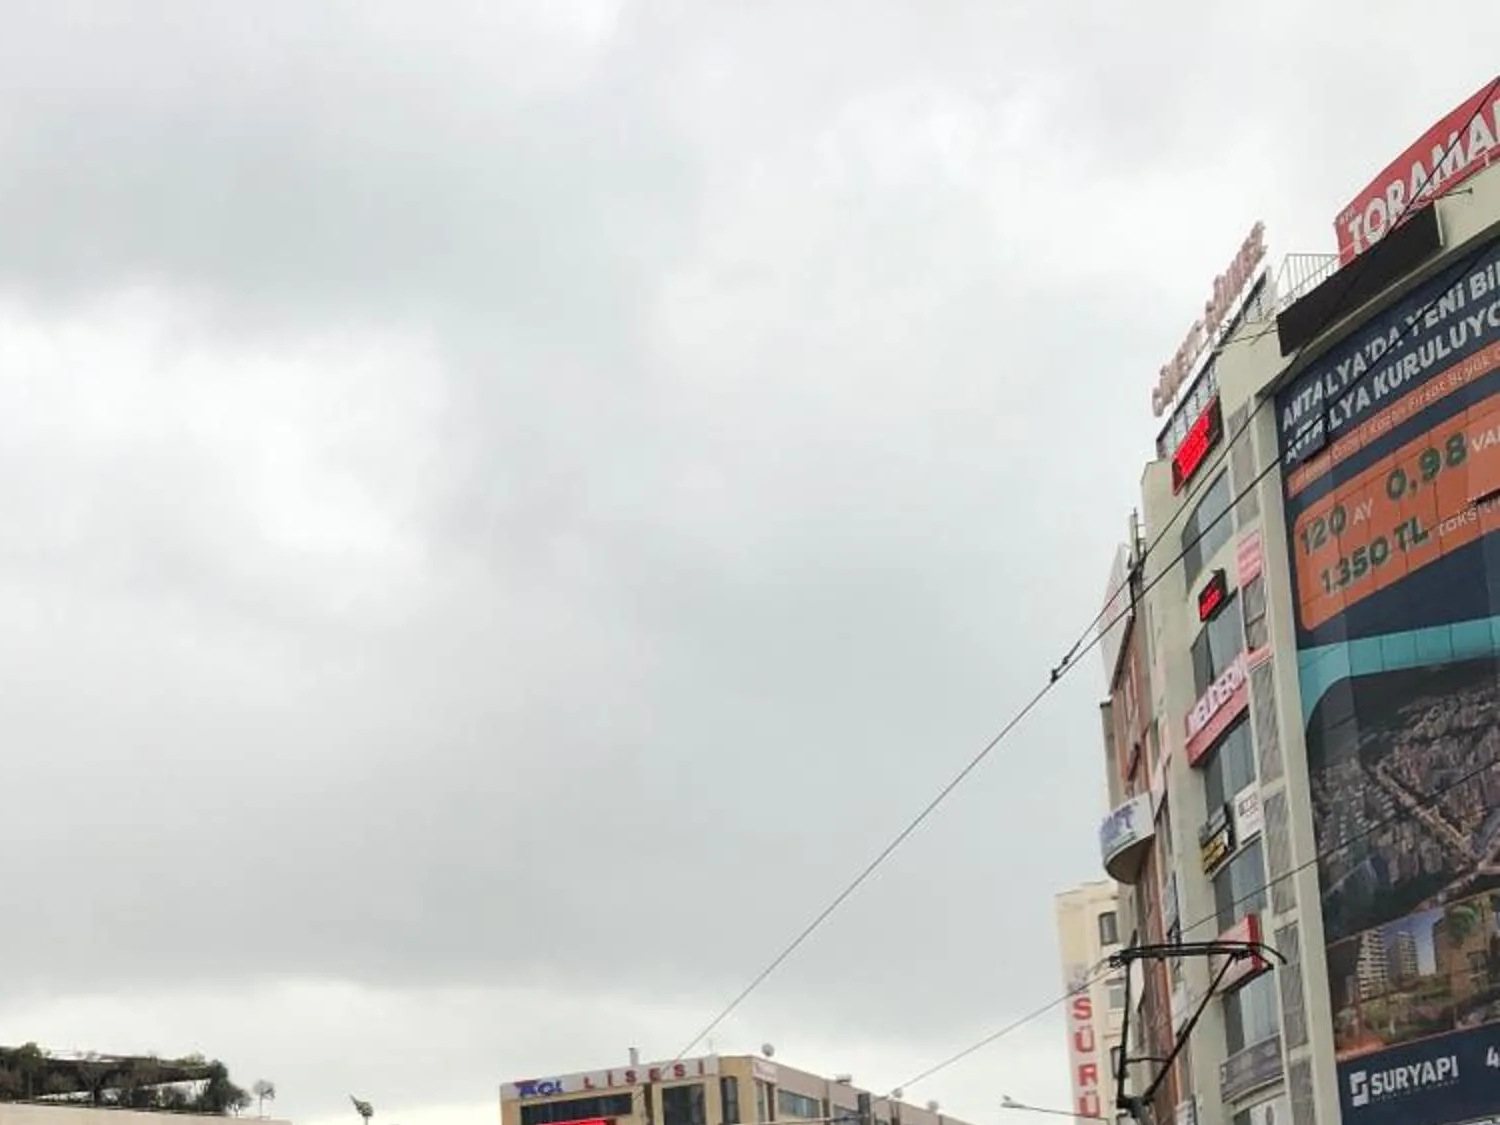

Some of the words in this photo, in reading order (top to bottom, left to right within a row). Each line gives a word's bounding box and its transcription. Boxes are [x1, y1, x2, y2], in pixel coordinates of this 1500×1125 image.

[1302, 503, 1347, 556] 120
[1353, 497, 1373, 526] AY
[1472, 425, 1500, 453] VA
[1393, 515, 1429, 553] TL
[1370, 1055, 1460, 1096] SURYAPI
